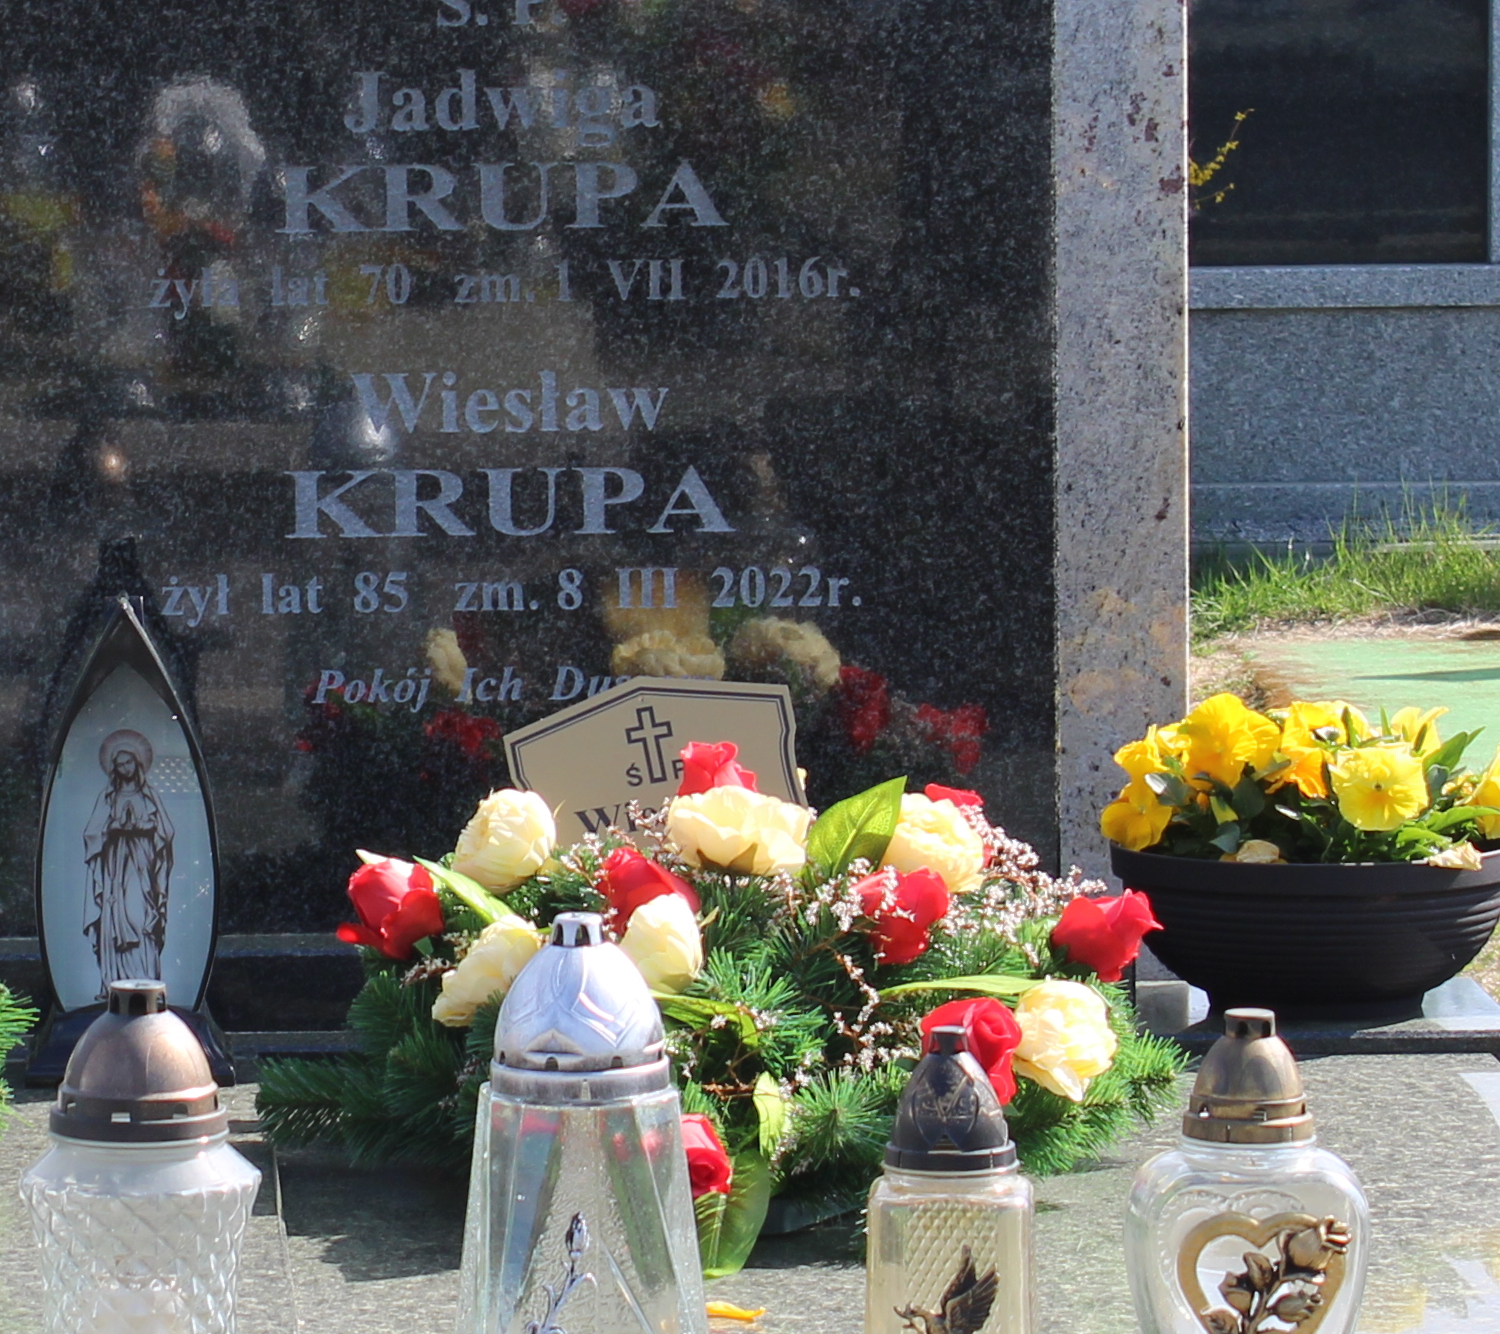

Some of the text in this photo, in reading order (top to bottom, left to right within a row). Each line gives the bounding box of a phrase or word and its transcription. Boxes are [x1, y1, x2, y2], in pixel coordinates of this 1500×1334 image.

[343, 68, 662, 147] Jadwiga
[274, 158, 731, 234] KRUPA
[270, 266, 330, 307] lat
[359, 263, 411, 305] 70
[453, 272, 536, 304] zm.
[554, 258, 574, 302] 1
[606, 258, 687, 302] VII
[715, 255, 861, 299] 2016r.
[350, 369, 670, 434] Wiesław
[282, 464, 737, 540] KRUPA
[160, 566, 863, 628] żył lat 85 zm. 8 III 2022r.
[311, 667, 432, 713] Pokój
[453, 667, 524, 702] Ich
